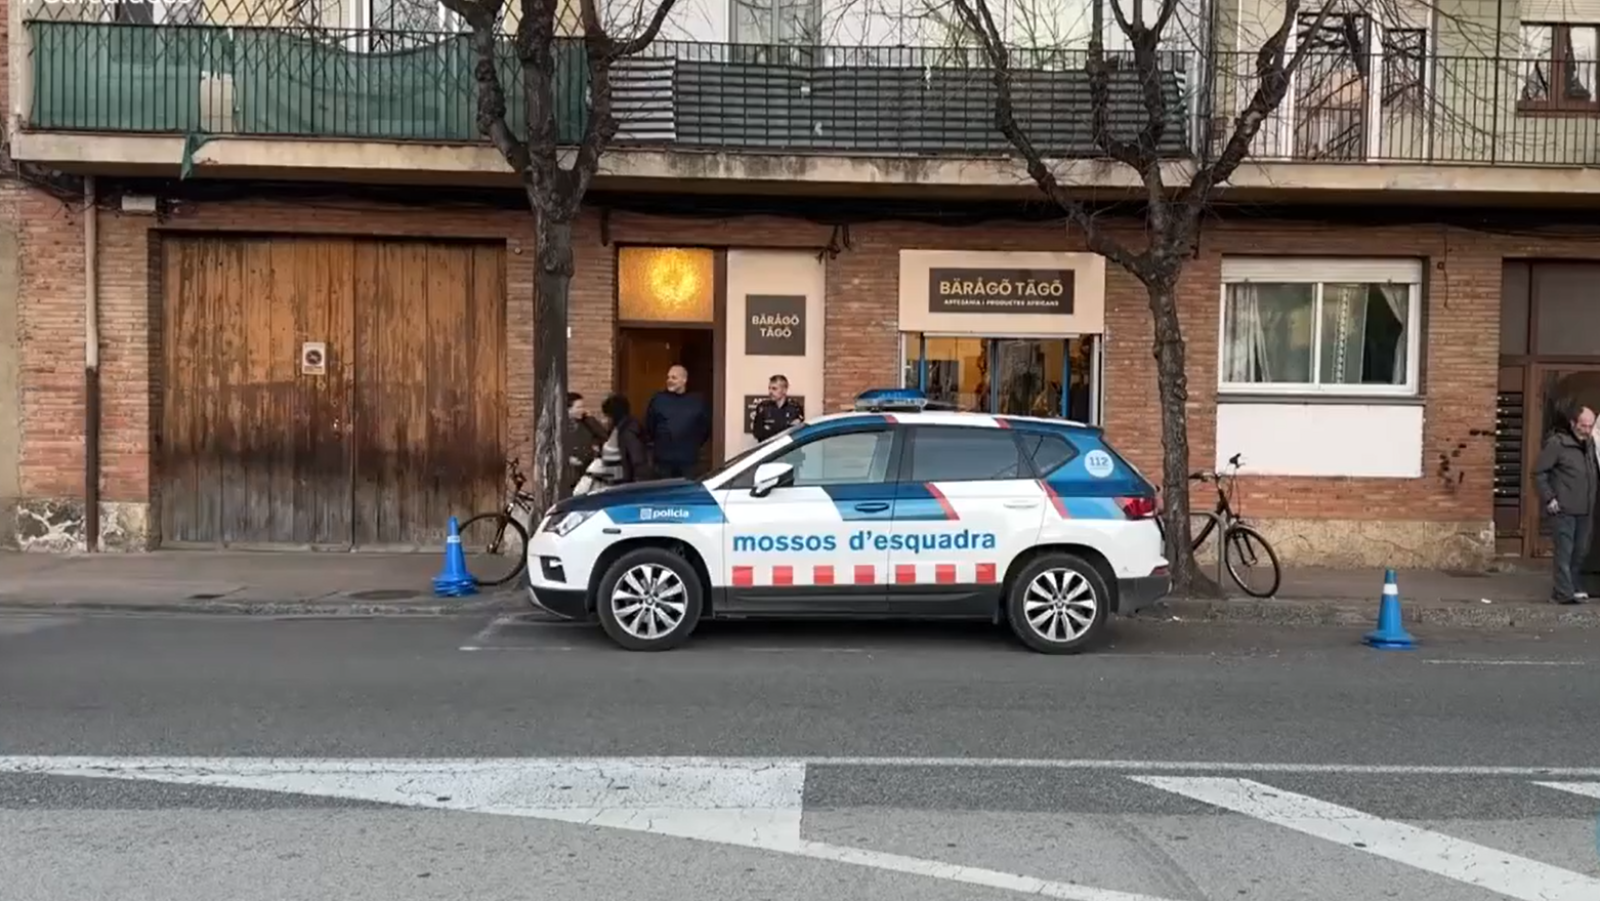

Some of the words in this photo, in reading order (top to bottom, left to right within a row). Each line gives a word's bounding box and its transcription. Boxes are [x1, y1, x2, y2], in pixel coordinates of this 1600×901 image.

[1089, 456, 1109, 466] 112
[733, 535, 837, 551] mossos
[849, 530, 996, 553] d'esquadra
